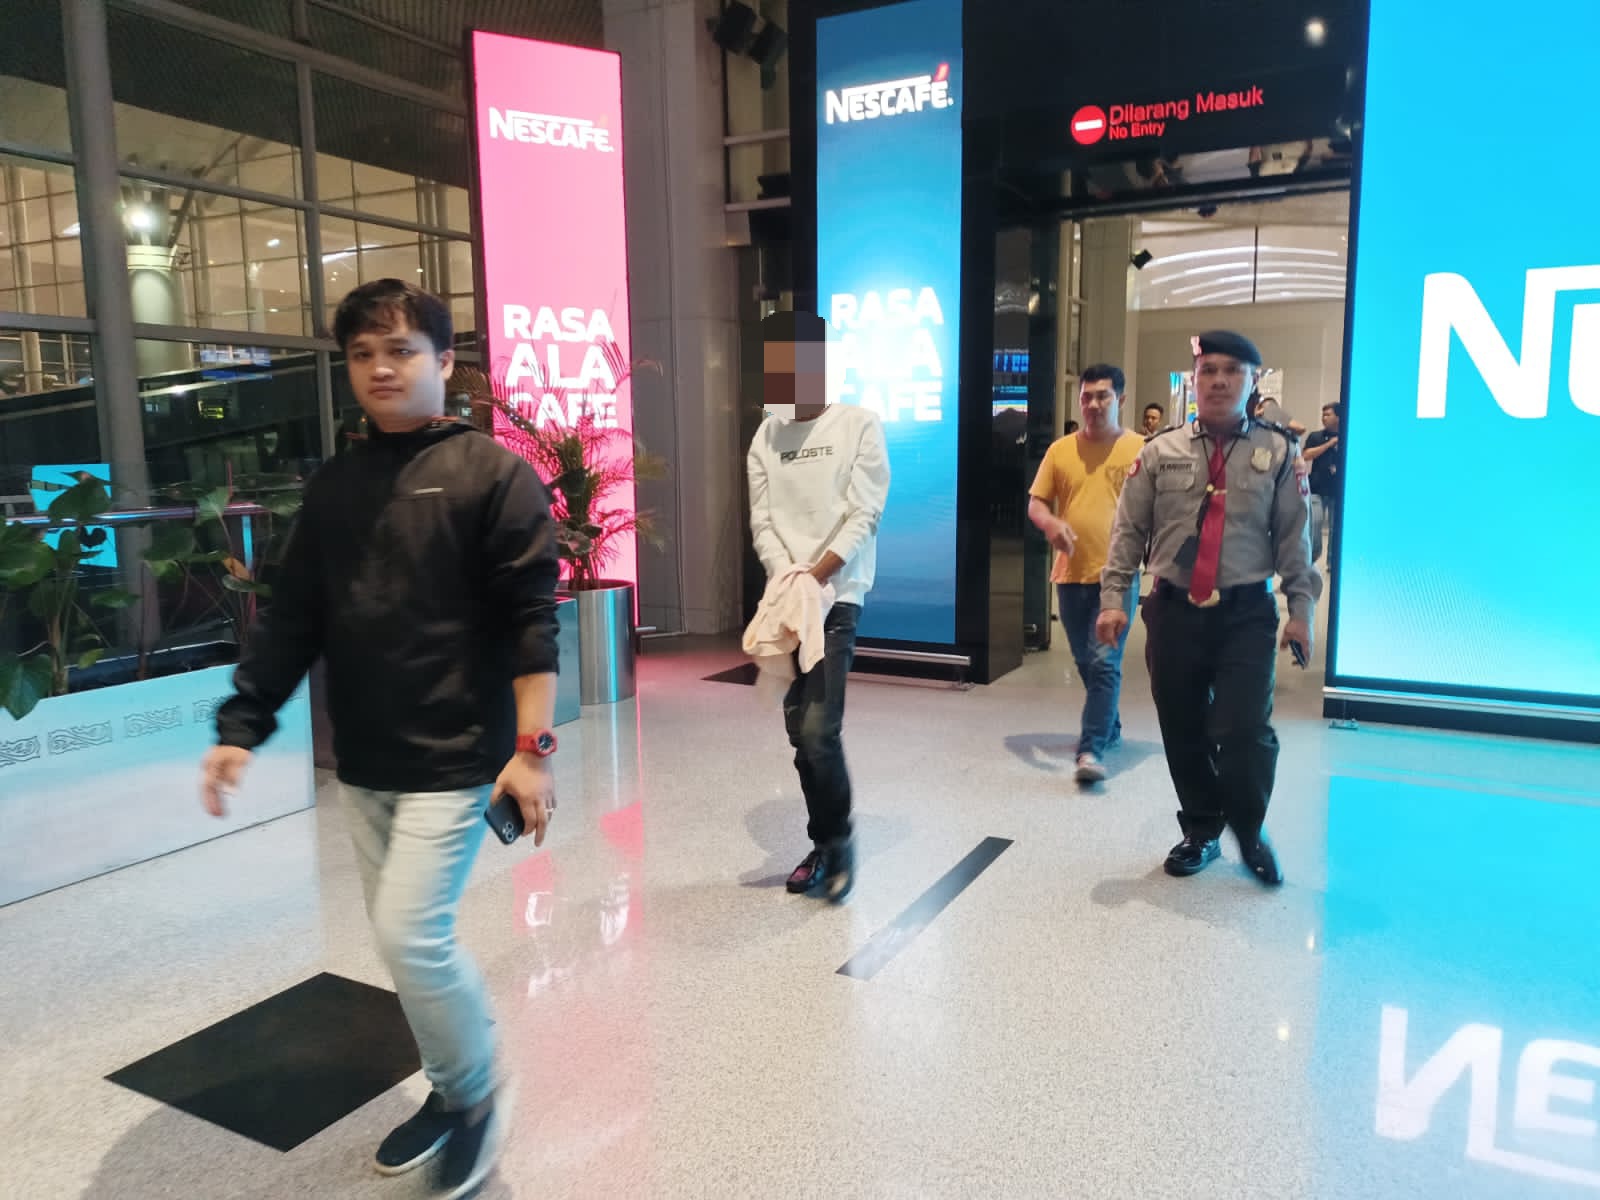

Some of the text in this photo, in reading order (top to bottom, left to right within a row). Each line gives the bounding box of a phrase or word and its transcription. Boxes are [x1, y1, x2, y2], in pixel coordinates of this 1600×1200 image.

[1109, 85, 1264, 126] Dilarang Masuk
[1109, 121, 1166, 141] No Entry
[503, 304, 616, 343] RASA
[831, 287, 944, 330] RASA
[505, 343, 618, 389] ALA
